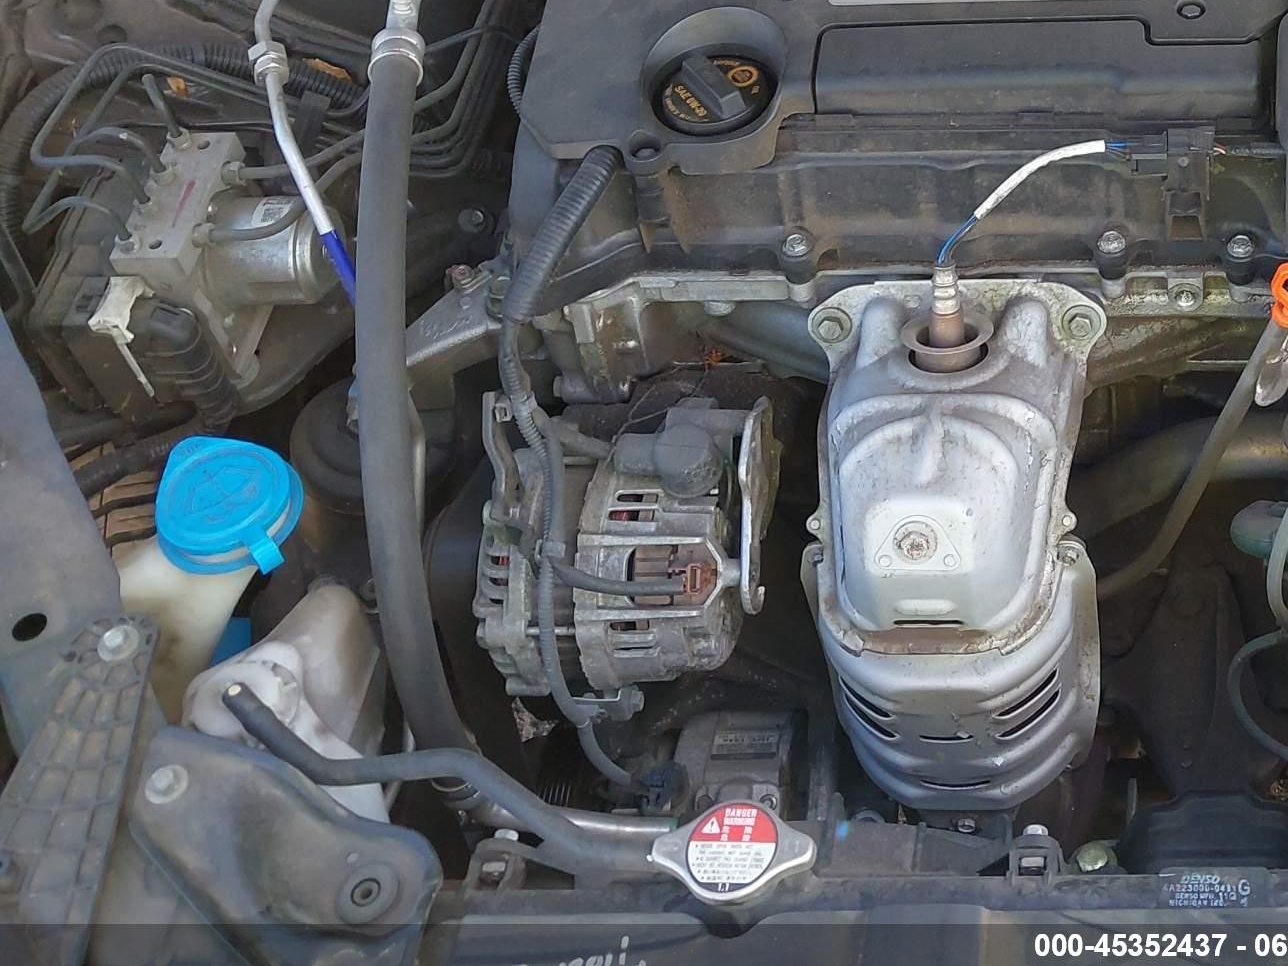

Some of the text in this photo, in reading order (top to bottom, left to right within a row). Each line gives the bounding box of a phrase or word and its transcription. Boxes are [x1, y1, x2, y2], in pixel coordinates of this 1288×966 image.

[674, 85, 693, 100] SAE
[725, 808, 758, 818] DANGER
[723, 817, 756, 826] WARNING
[1180, 873, 1220, 884] DENSO
[1238, 879, 1250, 895] G
[1169, 899, 1208, 907] MICHIGAN
